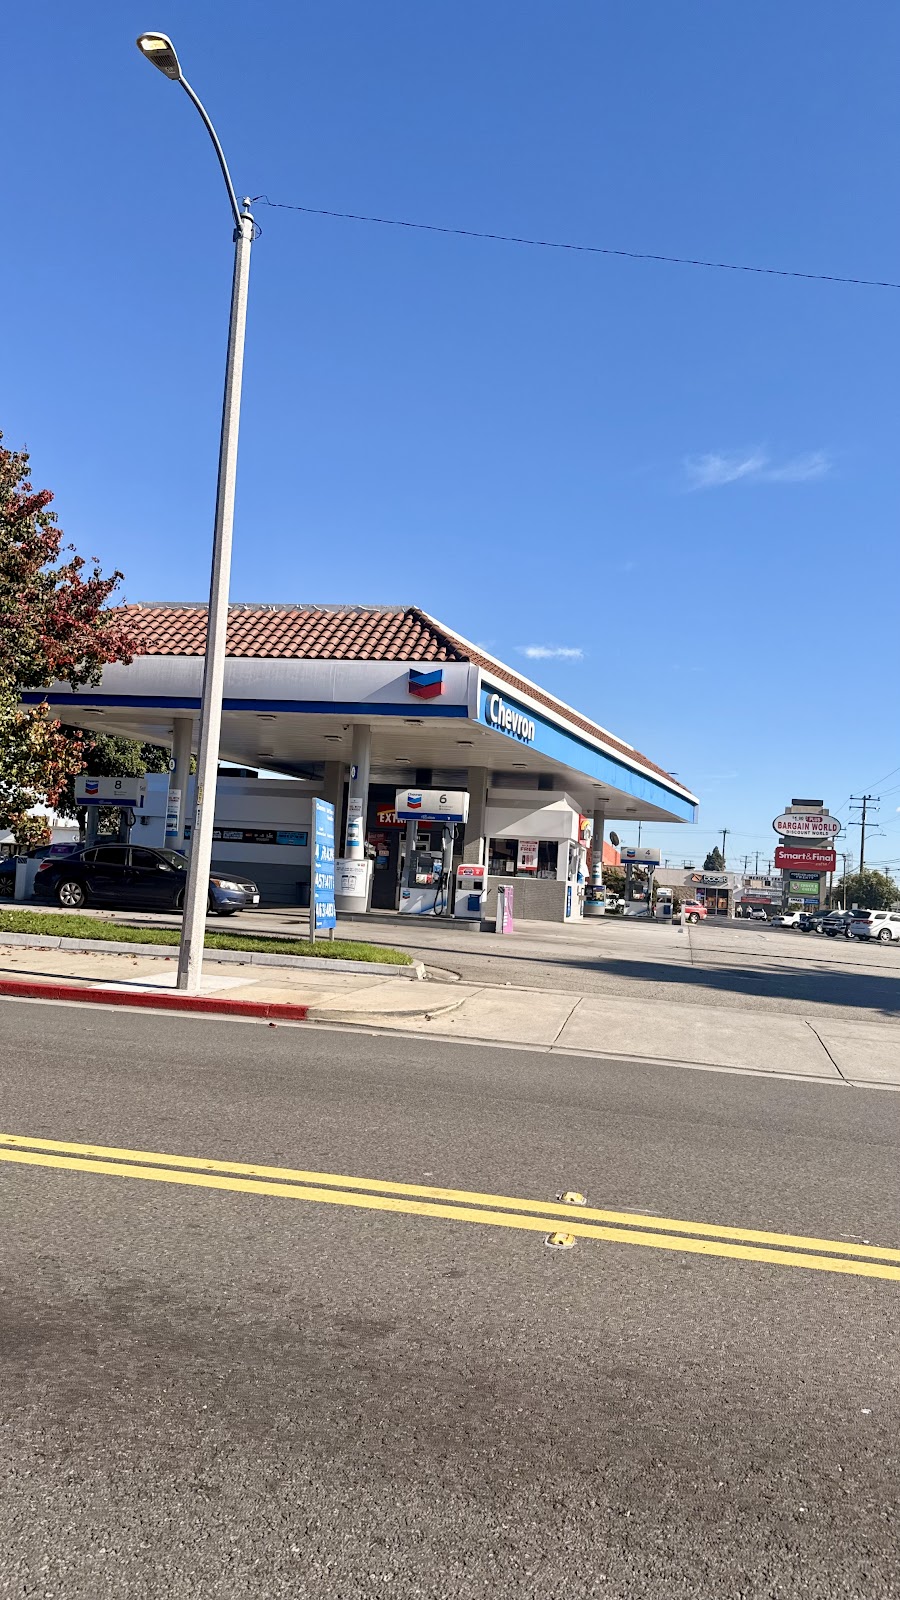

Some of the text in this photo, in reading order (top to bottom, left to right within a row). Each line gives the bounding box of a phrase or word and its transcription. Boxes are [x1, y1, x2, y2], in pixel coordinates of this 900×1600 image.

[489, 693, 536, 742] Chevron
[114, 780, 122, 790] 8
[439, 793, 447, 804] 6
[777, 821, 838, 832] BARGAIN WORLD
[778, 850, 834, 862] Smart&Final
[703, 874, 728, 883] boost
